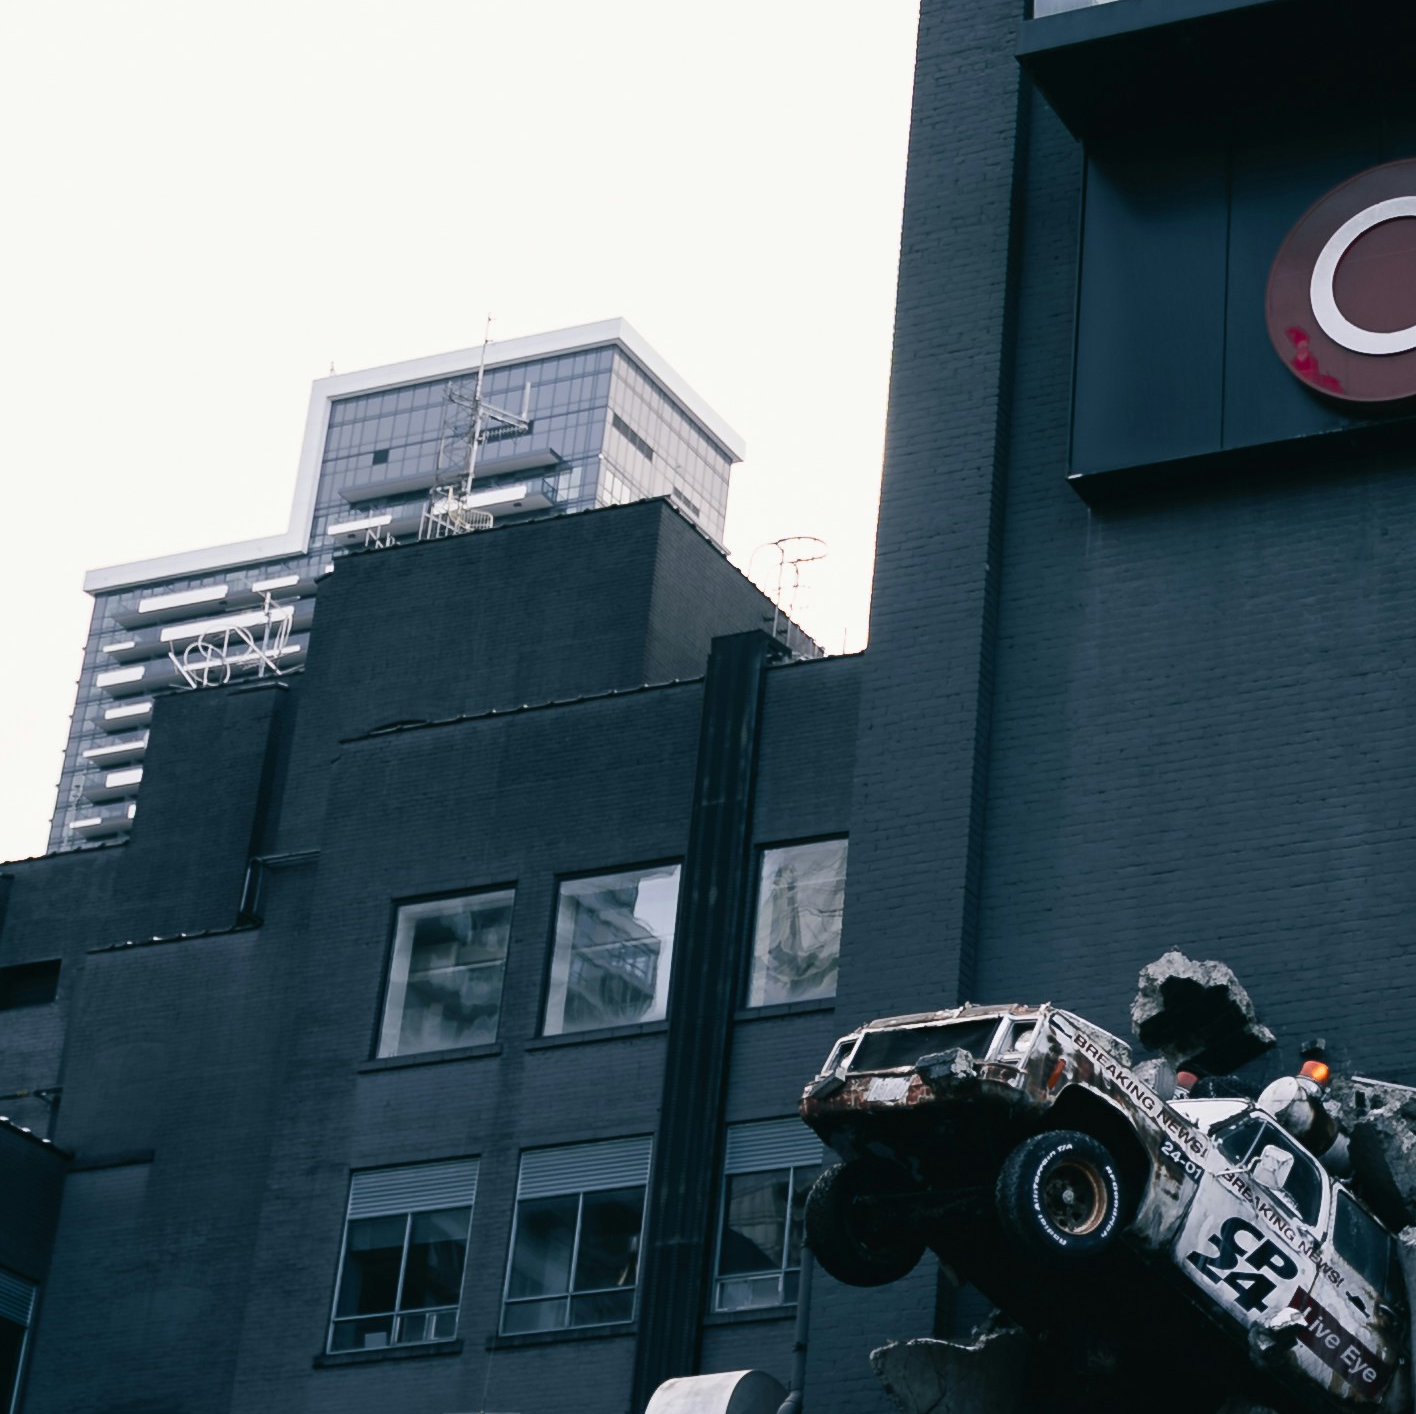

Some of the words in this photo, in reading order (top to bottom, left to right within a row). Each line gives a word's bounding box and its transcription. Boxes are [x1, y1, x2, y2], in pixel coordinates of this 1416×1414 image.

[1073, 1033, 1156, 1112] BREAKING
[1157, 1109, 1209, 1159] NEWS!
[1161, 1141, 1202, 1180] 24-01
[1340, 1344, 1378, 1384] Eye
